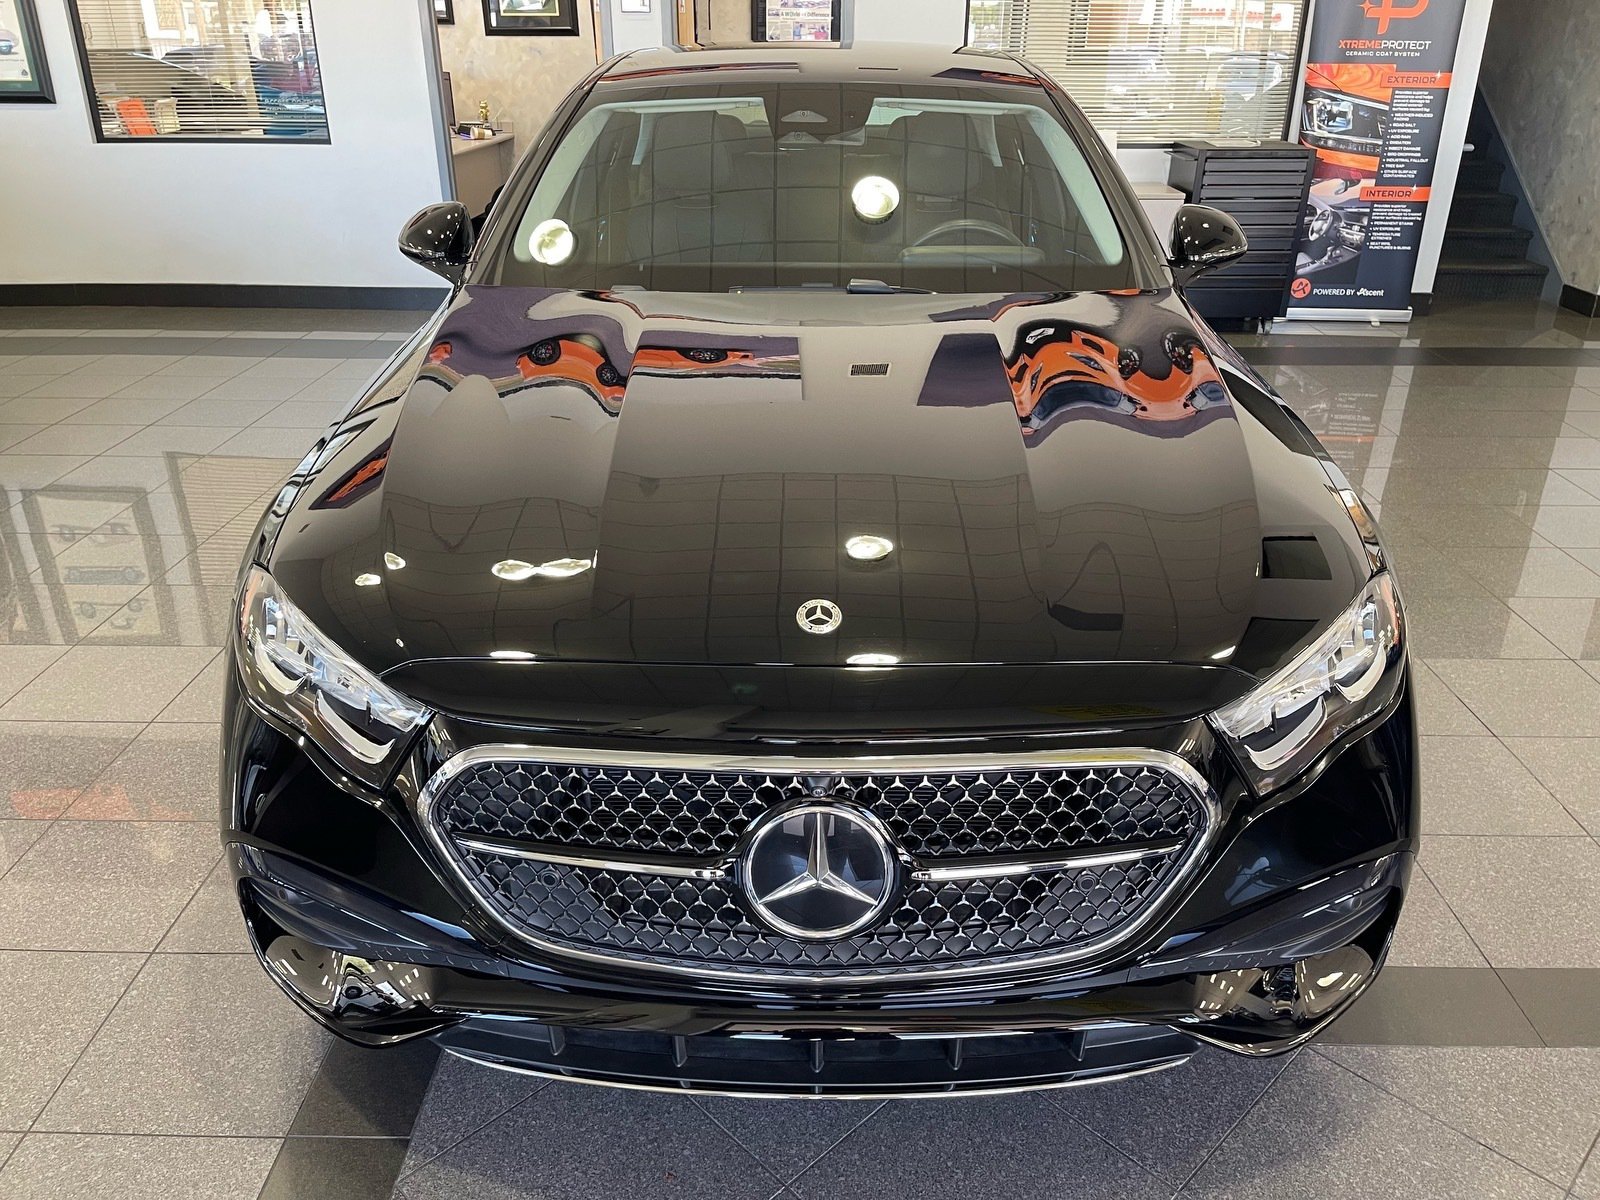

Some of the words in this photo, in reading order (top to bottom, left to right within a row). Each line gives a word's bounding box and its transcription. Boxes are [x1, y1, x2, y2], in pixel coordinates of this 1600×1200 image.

[1338, 40, 1432, 50] XTREMEPROTECT
[1387, 76, 1436, 84] EXTERIOR
[1366, 190, 1412, 198] INTERIOR
[1313, 288, 1345, 296] POWERED
[1357, 288, 1384, 296] Ascent
